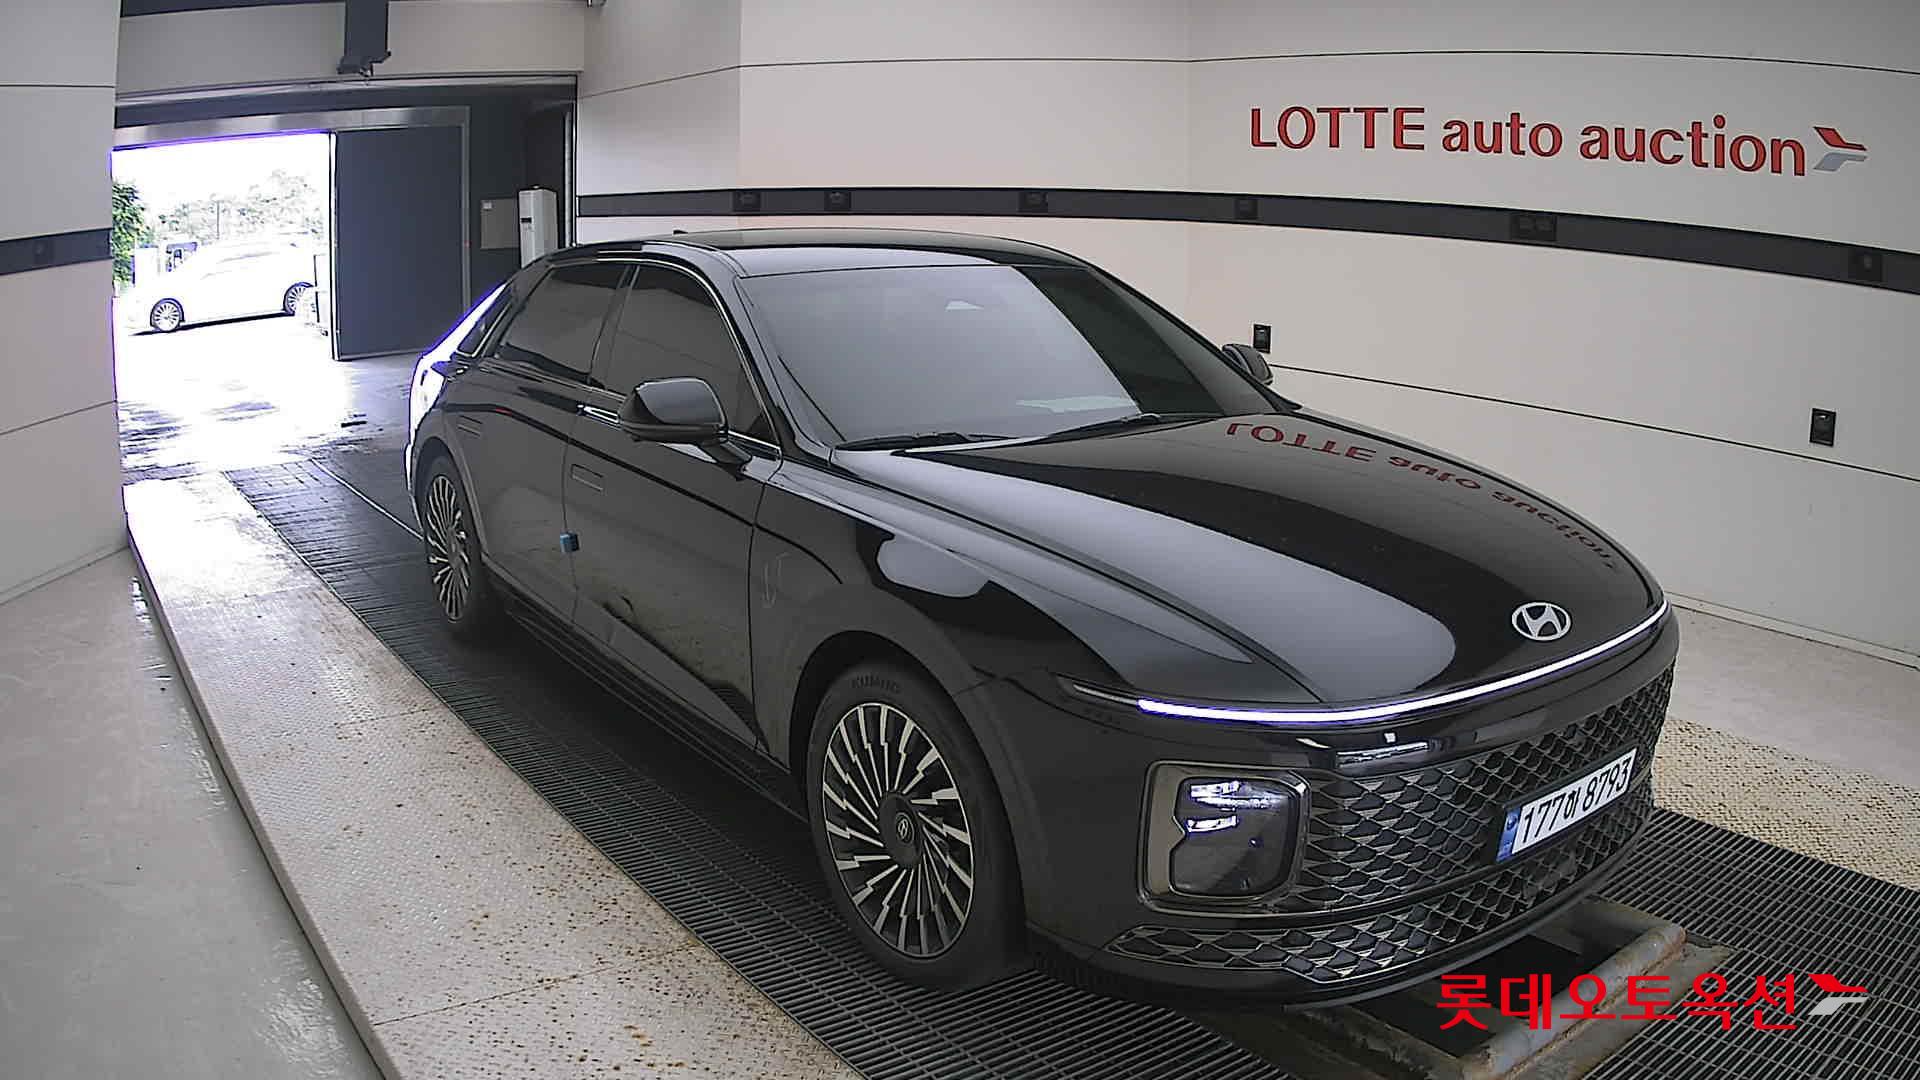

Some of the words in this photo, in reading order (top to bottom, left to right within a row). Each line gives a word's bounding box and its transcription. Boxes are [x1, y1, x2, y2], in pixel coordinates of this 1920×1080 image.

[1250, 106, 1425, 150] LOTTE
[1441, 113, 1563, 157] auto
[1579, 115, 1805, 177] auction
[1582, 757, 1632, 812] 8793
